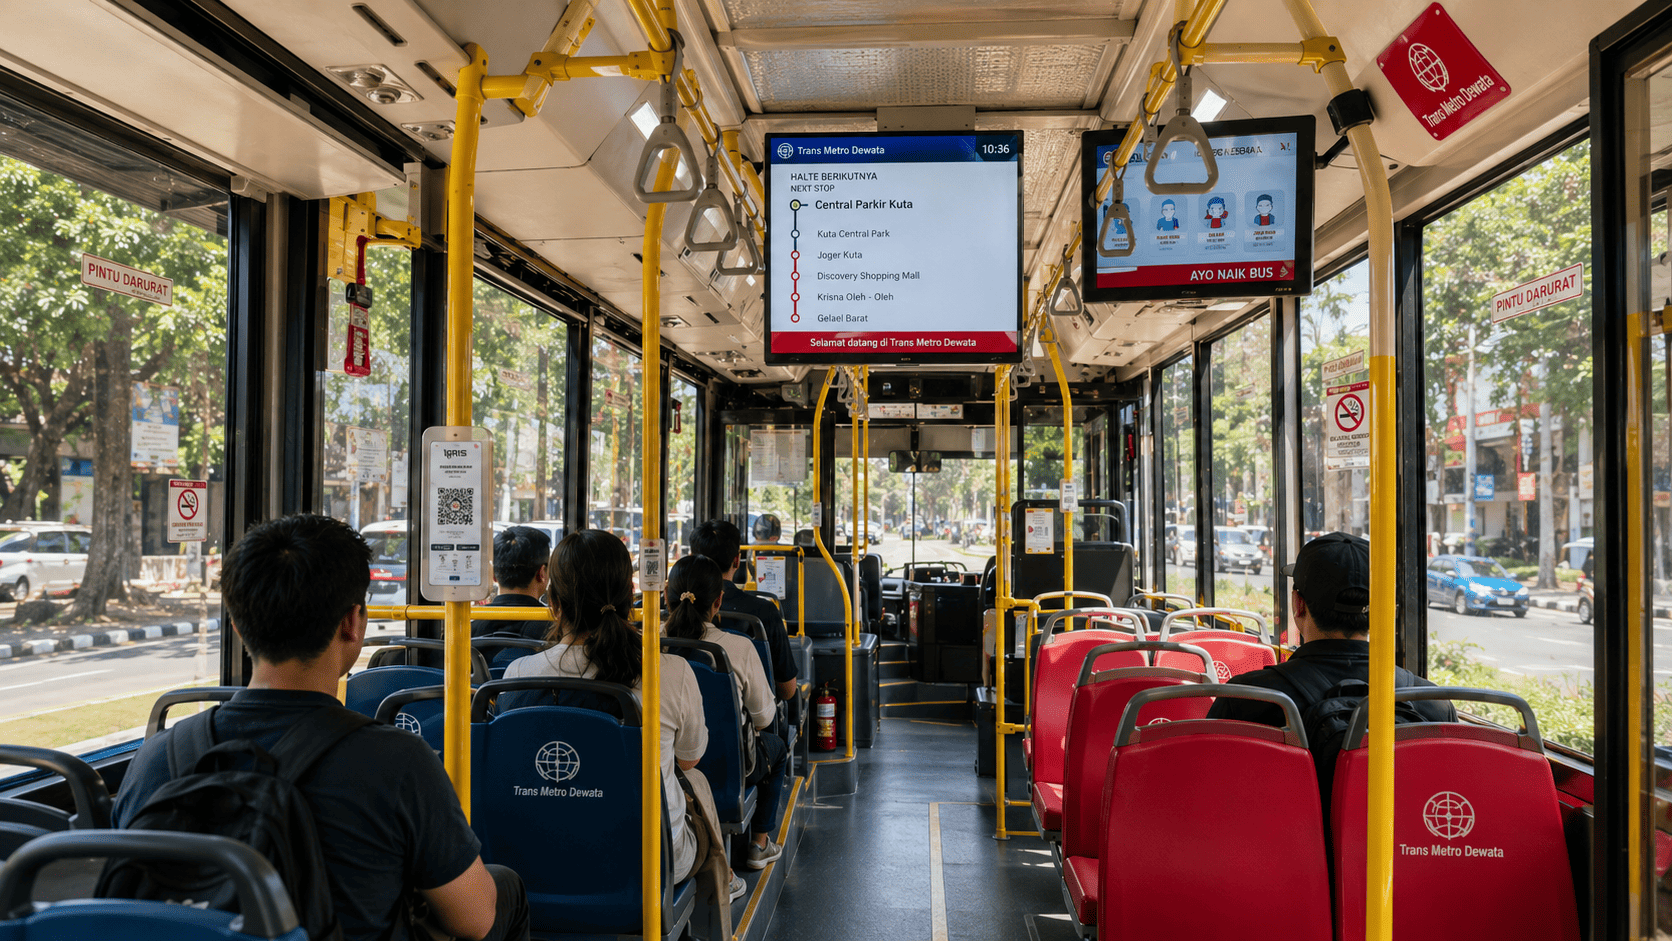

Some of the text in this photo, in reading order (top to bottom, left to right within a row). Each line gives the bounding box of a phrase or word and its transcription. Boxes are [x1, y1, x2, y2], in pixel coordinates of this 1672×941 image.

[1421, 74, 1495, 128] Trans Metro Dewata
[798, 146, 884, 154] Trans Metro Dewata
[982, 144, 1010, 154] 10:36
[790, 172, 878, 180] HALTE BERIKUTNYA
[790, 184, 834, 192] NEXT STOP
[816, 200, 912, 210] Central Parkir Kuta
[838, 230, 870, 238] Central
[872, 230, 890, 238] Park
[818, 250, 862, 262] Joger Kuta
[818, 272, 920, 282] Discovery Shopping Mall
[1190, 266, 1274, 280] AYO NAIK BUS
[88, 263, 120, 282] PINTU
[124, 274, 168, 296] DARURAT
[818, 292, 844, 302] Krisna
[846, 292, 866, 302] Oleh
[874, 292, 894, 300] Oleh
[1496, 274, 1576, 312] PINTU DARURAT
[818, 314, 868, 322] Gelael Barat
[810, 338, 976, 348] Selamat datang di Trans Metro Dewata
[514, 786, 604, 798] Trans Metro Dewata
[1400, 844, 1504, 858] Trans Metro Dewata
